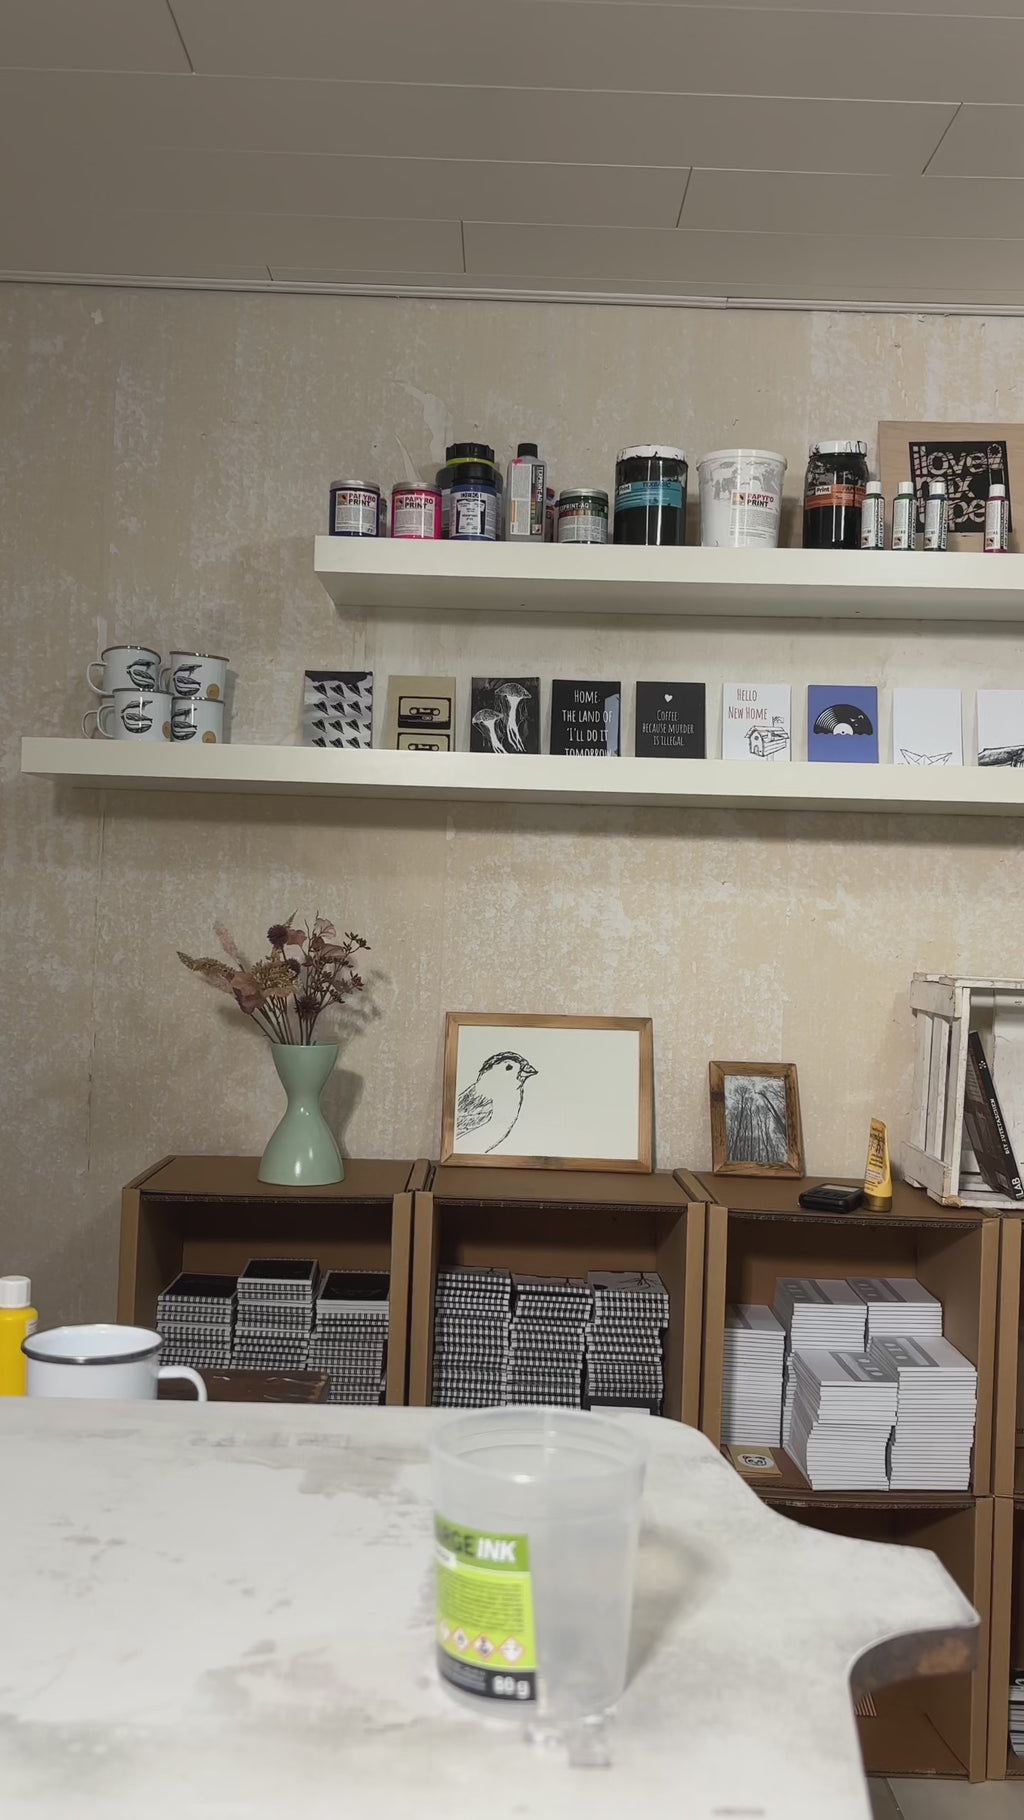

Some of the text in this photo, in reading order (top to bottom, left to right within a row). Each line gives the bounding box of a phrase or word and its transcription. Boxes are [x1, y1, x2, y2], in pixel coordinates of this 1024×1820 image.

[816, 486, 830, 494] Print
[348, 492, 376, 503] PAPYRO
[348, 498, 371, 508] PRINT
[405, 496, 434, 505] PAPYRO
[404, 502, 427, 510] PRINT
[747, 499, 769, 508] PRINT
[736, 688, 758, 702] HELLO
[562, 709, 613, 724] THE LAND OF
[728, 706, 768, 721] NEW HOME
[642, 722, 695, 735] BECAUSE MURDER
[586, 729, 598, 742] DO
[600, 729, 609, 742] IT
[653, 735, 684, 746] IS ILLEGAL
[1011, 1177, 1024, 1199] LAB
